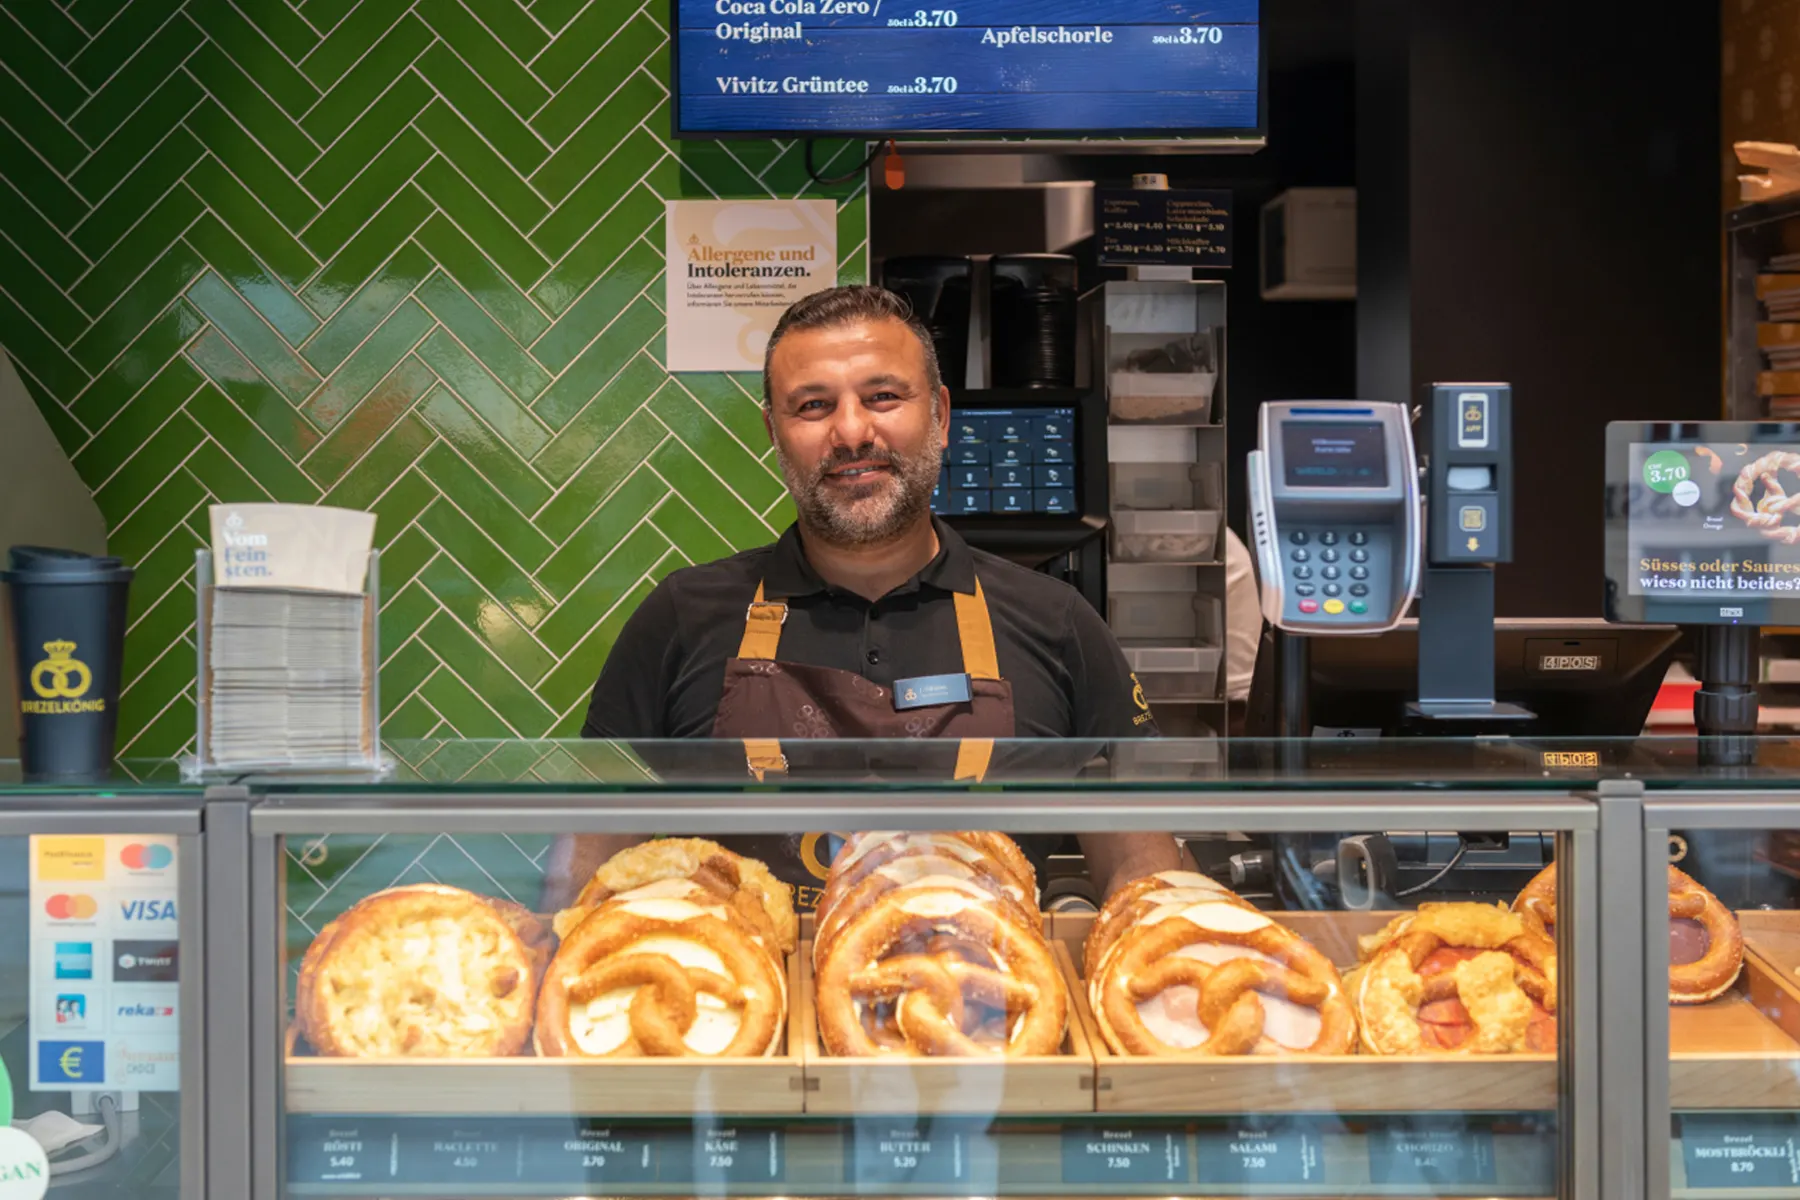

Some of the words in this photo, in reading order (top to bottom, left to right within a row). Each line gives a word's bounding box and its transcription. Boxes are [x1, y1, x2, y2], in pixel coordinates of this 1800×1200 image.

[715, 0, 766, 15] Coca
[769, 0, 816, 15] Cola
[820, 0, 870, 15] Zero
[914, 10, 958, 27] 3.70
[715, 21, 803, 43] Original
[980, 26, 1114, 48] Apfelschorle
[1179, 27, 1223, 44] 3.70
[716, 76, 778, 94] Vivitz
[782, 76, 869, 94] Grüntee
[914, 76, 958, 94] 3.70
[687, 246, 775, 264] Allergene
[780, 245, 815, 261] und
[687, 262, 811, 278] Intoleranzen.
[1650, 466, 1687, 483] 3.70
[222, 529, 268, 546] Vom
[1640, 558, 1697, 572] Süsses
[1699, 559, 1739, 573] oder
[1640, 574, 1687, 589] wieso
[1690, 575, 1734, 590] nicht
[1737, 576, 1800, 591] beides?
[120, 899, 177, 921] VISA
[117, 1003, 156, 1017] reka
[563, 1140, 625, 1152] ORIGINAL
[880, 1141, 931, 1153] BUTTER
[1086, 1142, 1150, 1153] SCHINKEN
[1229, 1142, 1277, 1153] SALAMI
[1107, 1157, 1131, 1168] 7.50
[1242, 1156, 1266, 1168] 7.50
